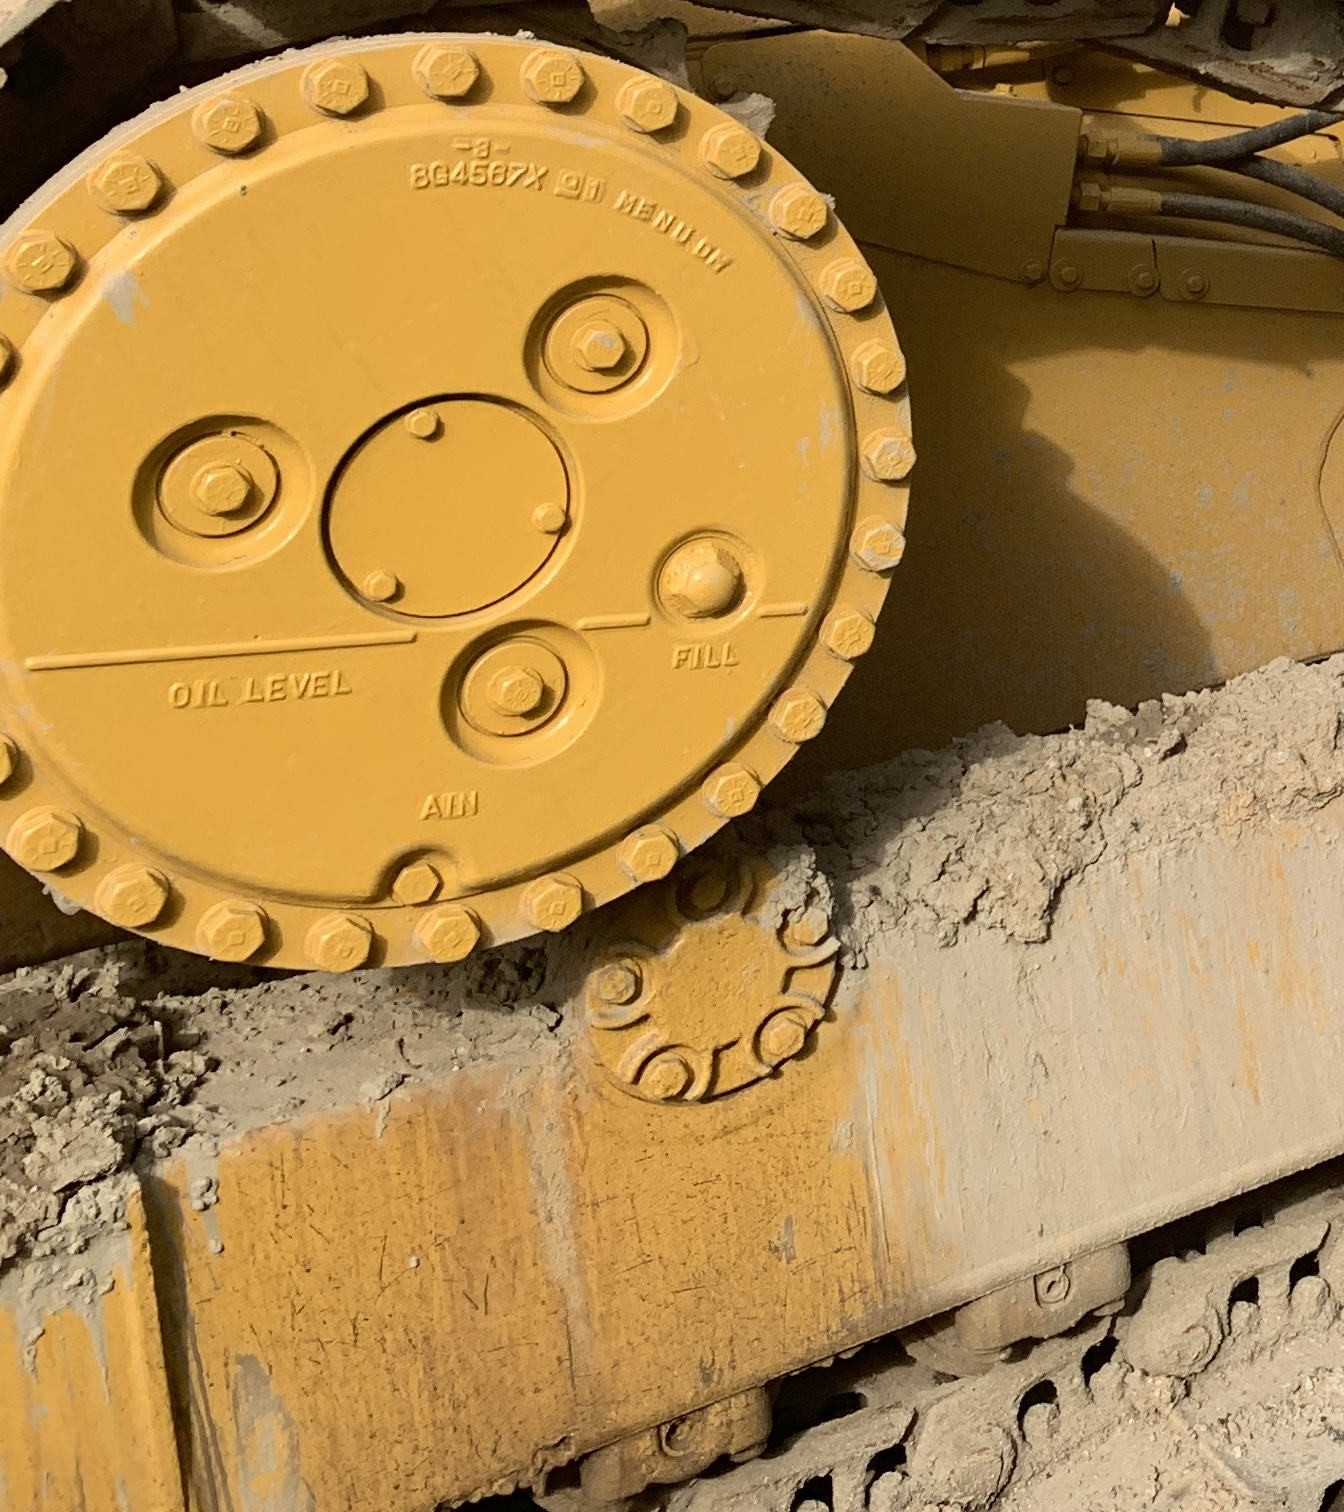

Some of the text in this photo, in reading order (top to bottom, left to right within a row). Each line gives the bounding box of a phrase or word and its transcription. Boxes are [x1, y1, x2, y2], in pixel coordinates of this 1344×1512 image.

[671, 642, 740, 671] FILL
[168, 669, 353, 709] OIL LEVEL
